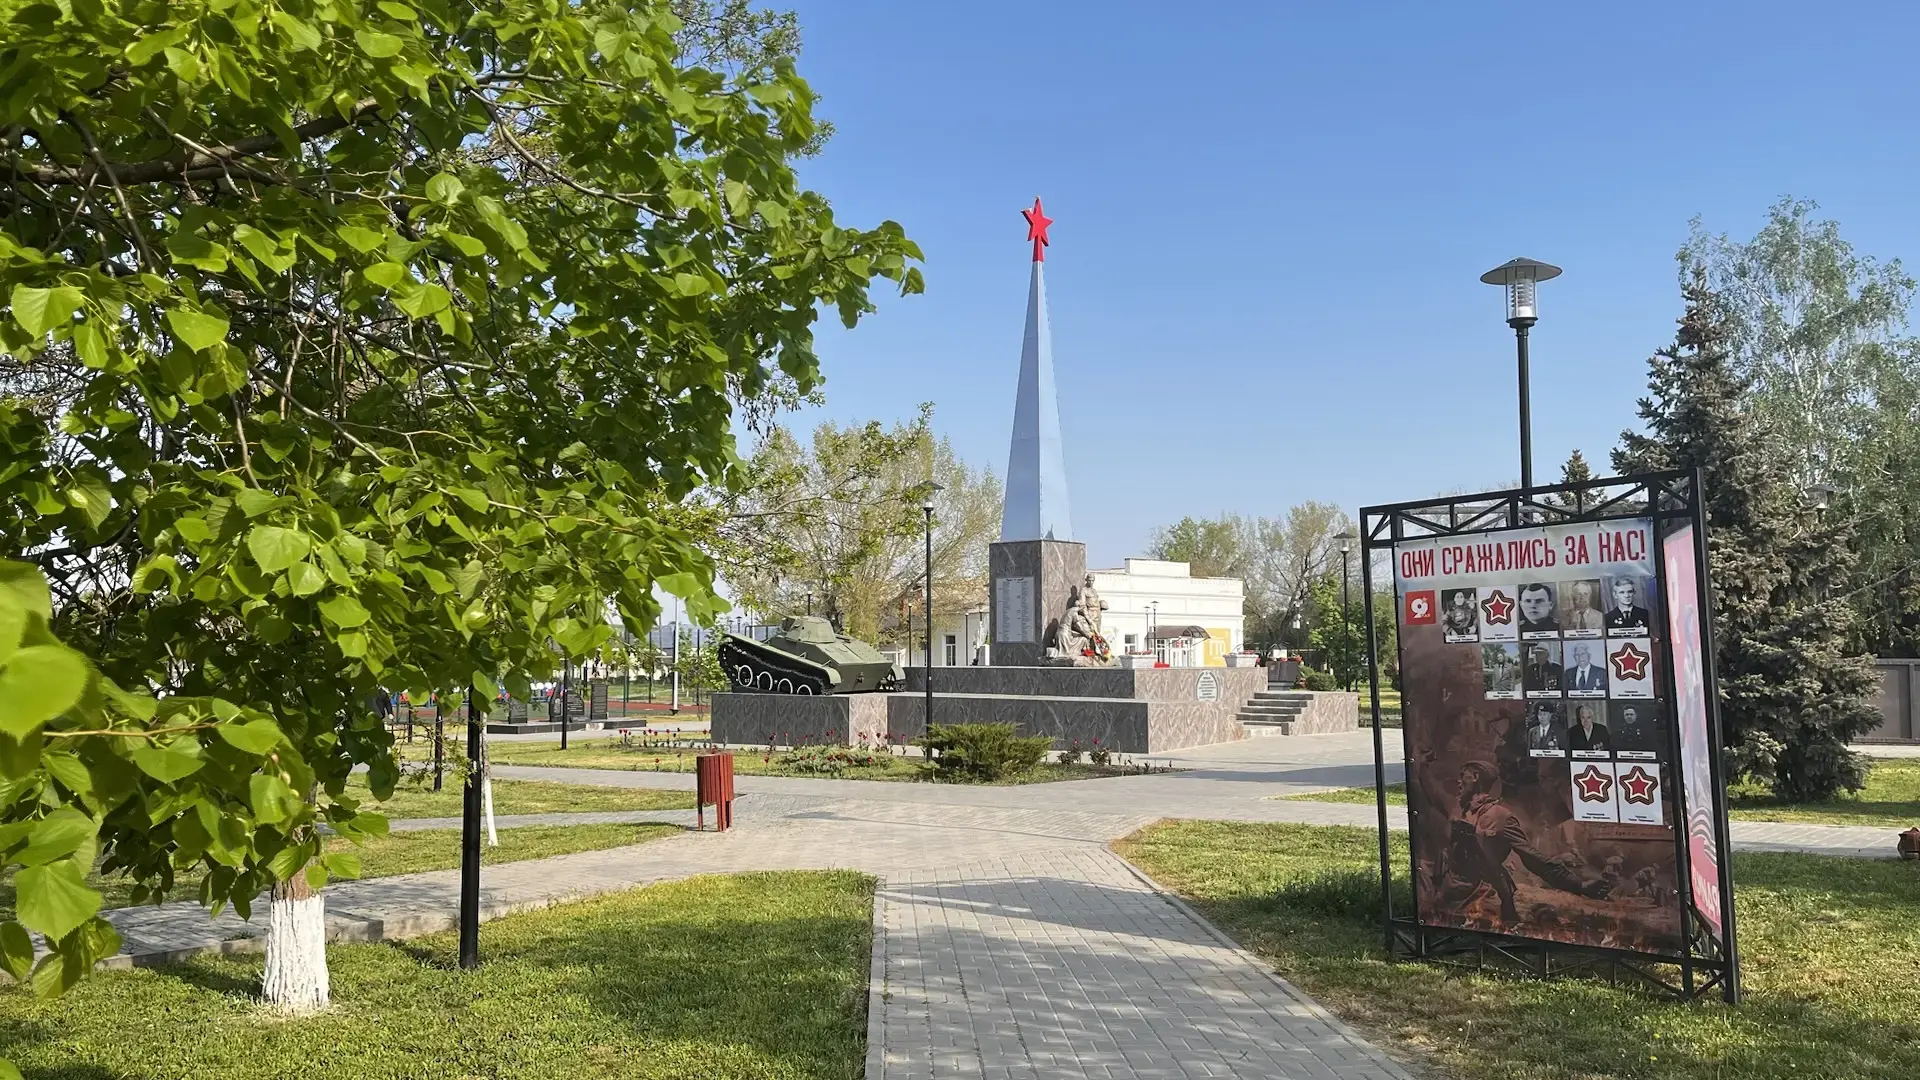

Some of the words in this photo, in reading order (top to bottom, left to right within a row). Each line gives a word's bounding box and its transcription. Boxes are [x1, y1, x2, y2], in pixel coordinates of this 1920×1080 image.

[1401, 549, 1434, 578] ОНИ
[1442, 538, 1556, 575] СРАЖАЛИСЬ
[1564, 534, 1590, 566] ЗА
[1598, 529, 1646, 563] НАС!
[1411, 597, 1429, 619] 9
